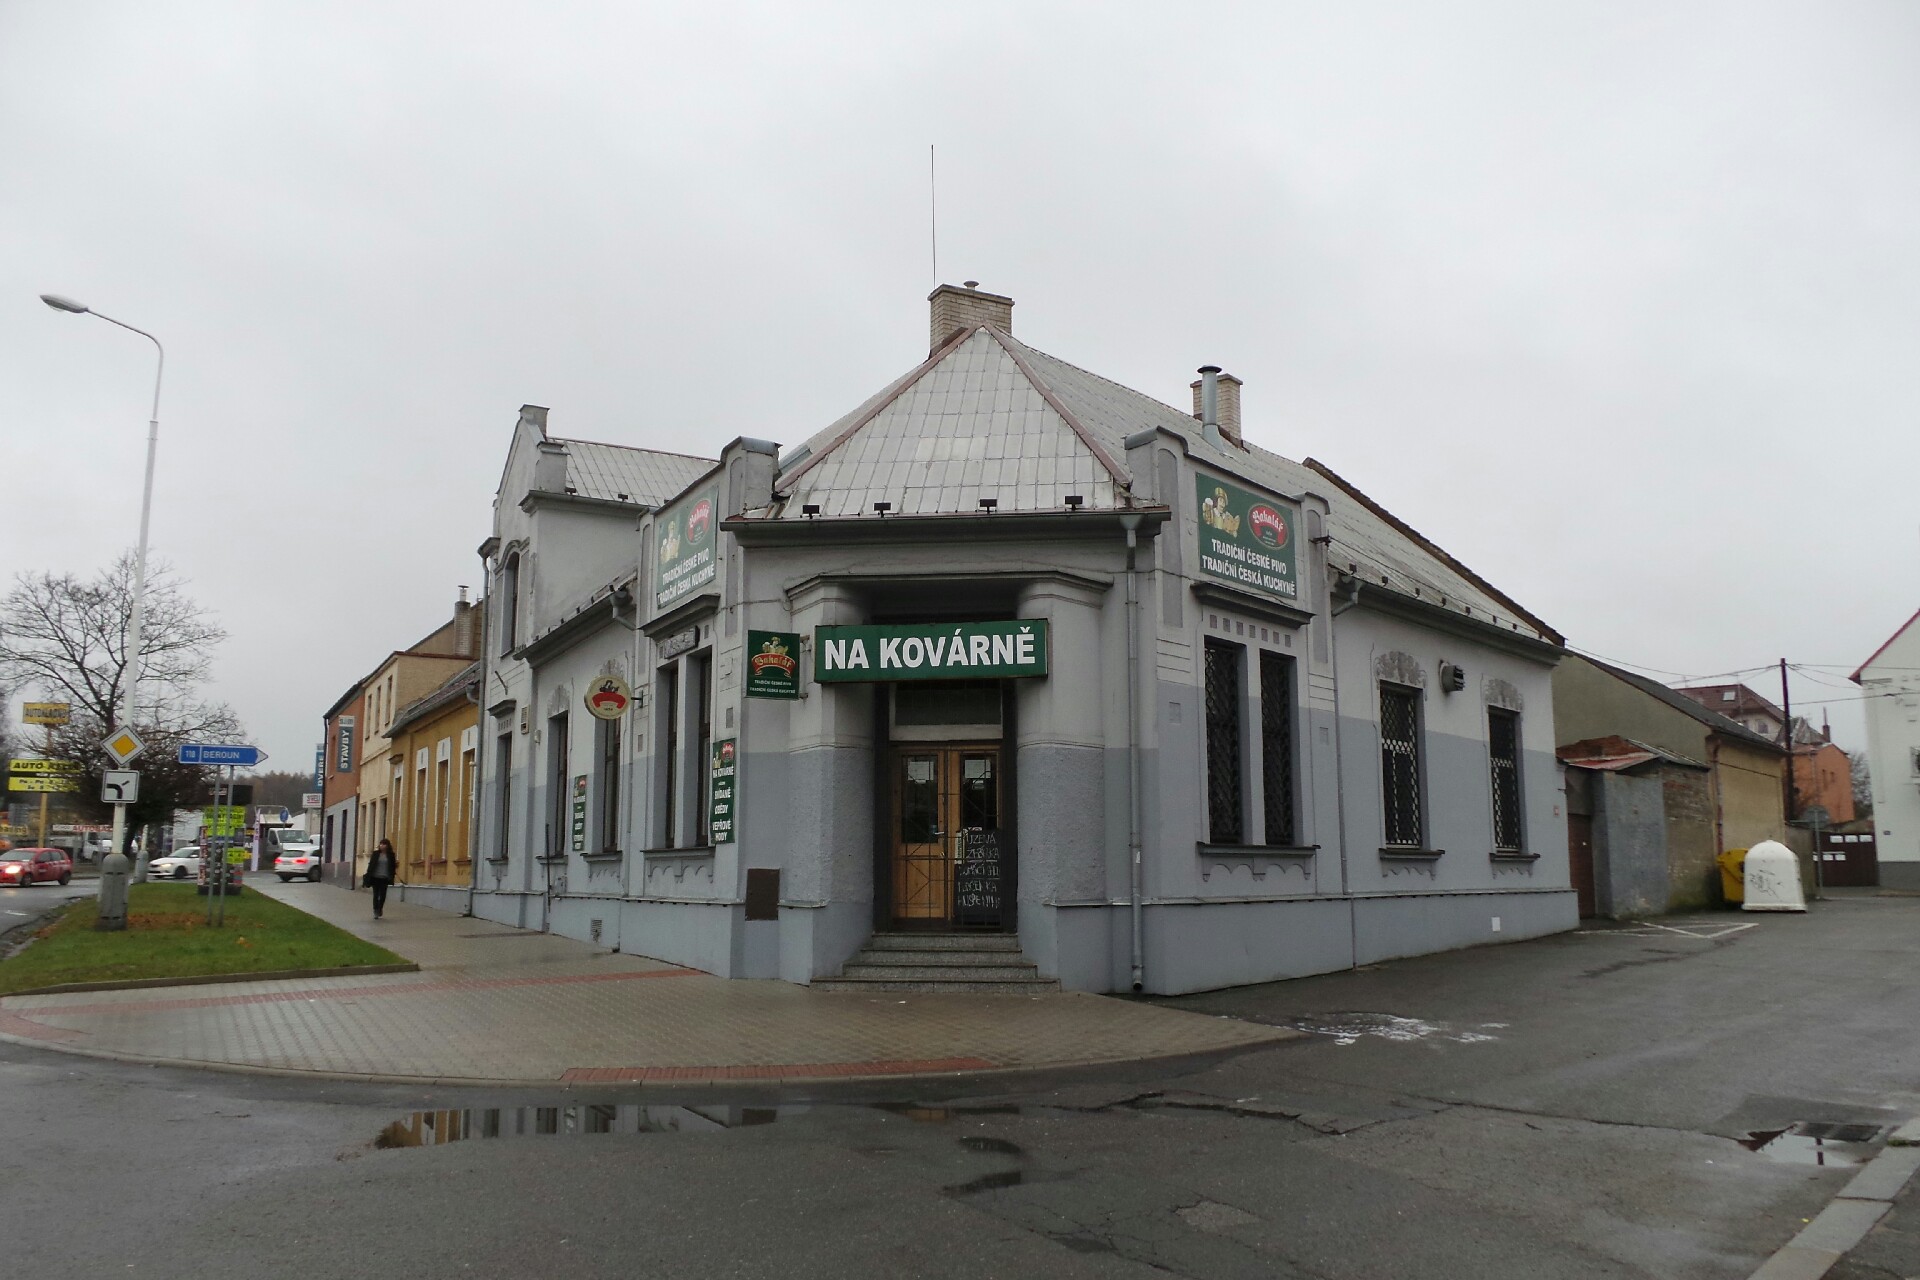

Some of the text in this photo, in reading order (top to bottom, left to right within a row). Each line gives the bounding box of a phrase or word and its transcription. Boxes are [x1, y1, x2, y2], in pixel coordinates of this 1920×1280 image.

[662, 548, 709, 585] TRADIČNÍ ČESKÉ PIVO
[1202, 555, 1237, 578] TRADIČNÍ
[1238, 565, 1262, 586] ČESKÁ
[1211, 538, 1245, 561] TRADIČNÍ
[1247, 549, 1270, 569] ČESKÉ
[1271, 559, 1287, 575] PIVO
[754, 655, 792, 668] Bakalář
[824, 626, 1036, 670] NA KOVÁRNĚ
[203, 750, 240, 759] BEROUN
[340, 730, 350, 769] STAVBY
